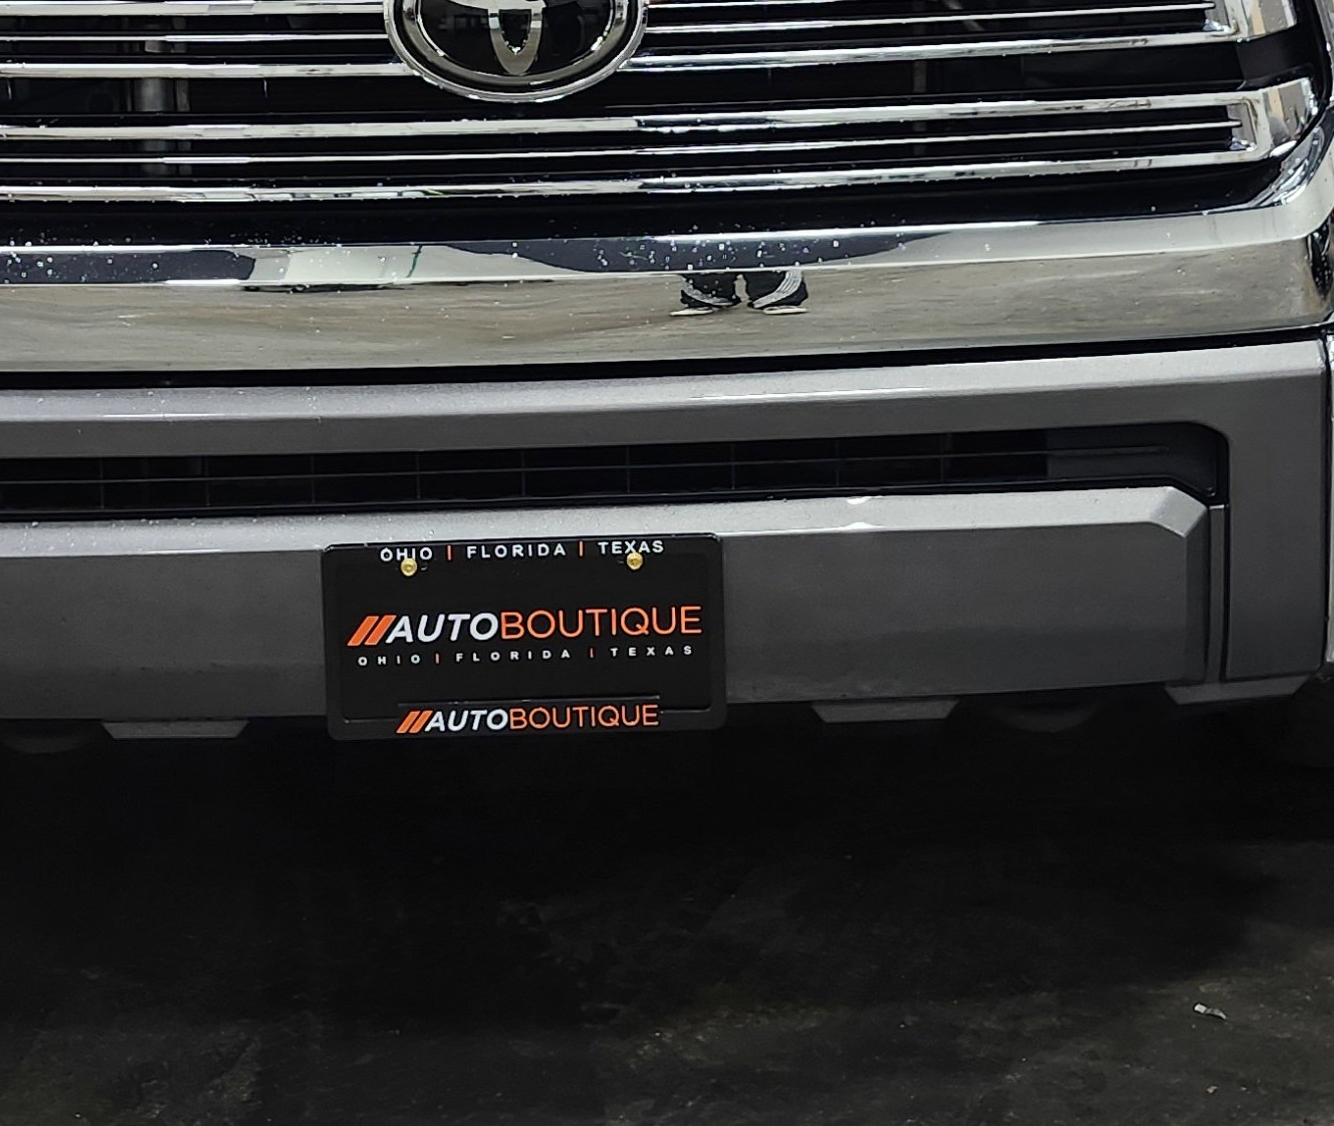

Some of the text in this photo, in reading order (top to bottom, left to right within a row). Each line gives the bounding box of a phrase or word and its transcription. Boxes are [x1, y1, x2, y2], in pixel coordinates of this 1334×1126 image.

[380, 540, 665, 563] OHIO FLORIDA TEXAS
[385, 605, 703, 645] AUTOBOUTIQUE
[357, 645, 693, 667] OHIO FLORIDA TEXAS
[424, 704, 660, 733] AUTOBOUTIQUE
